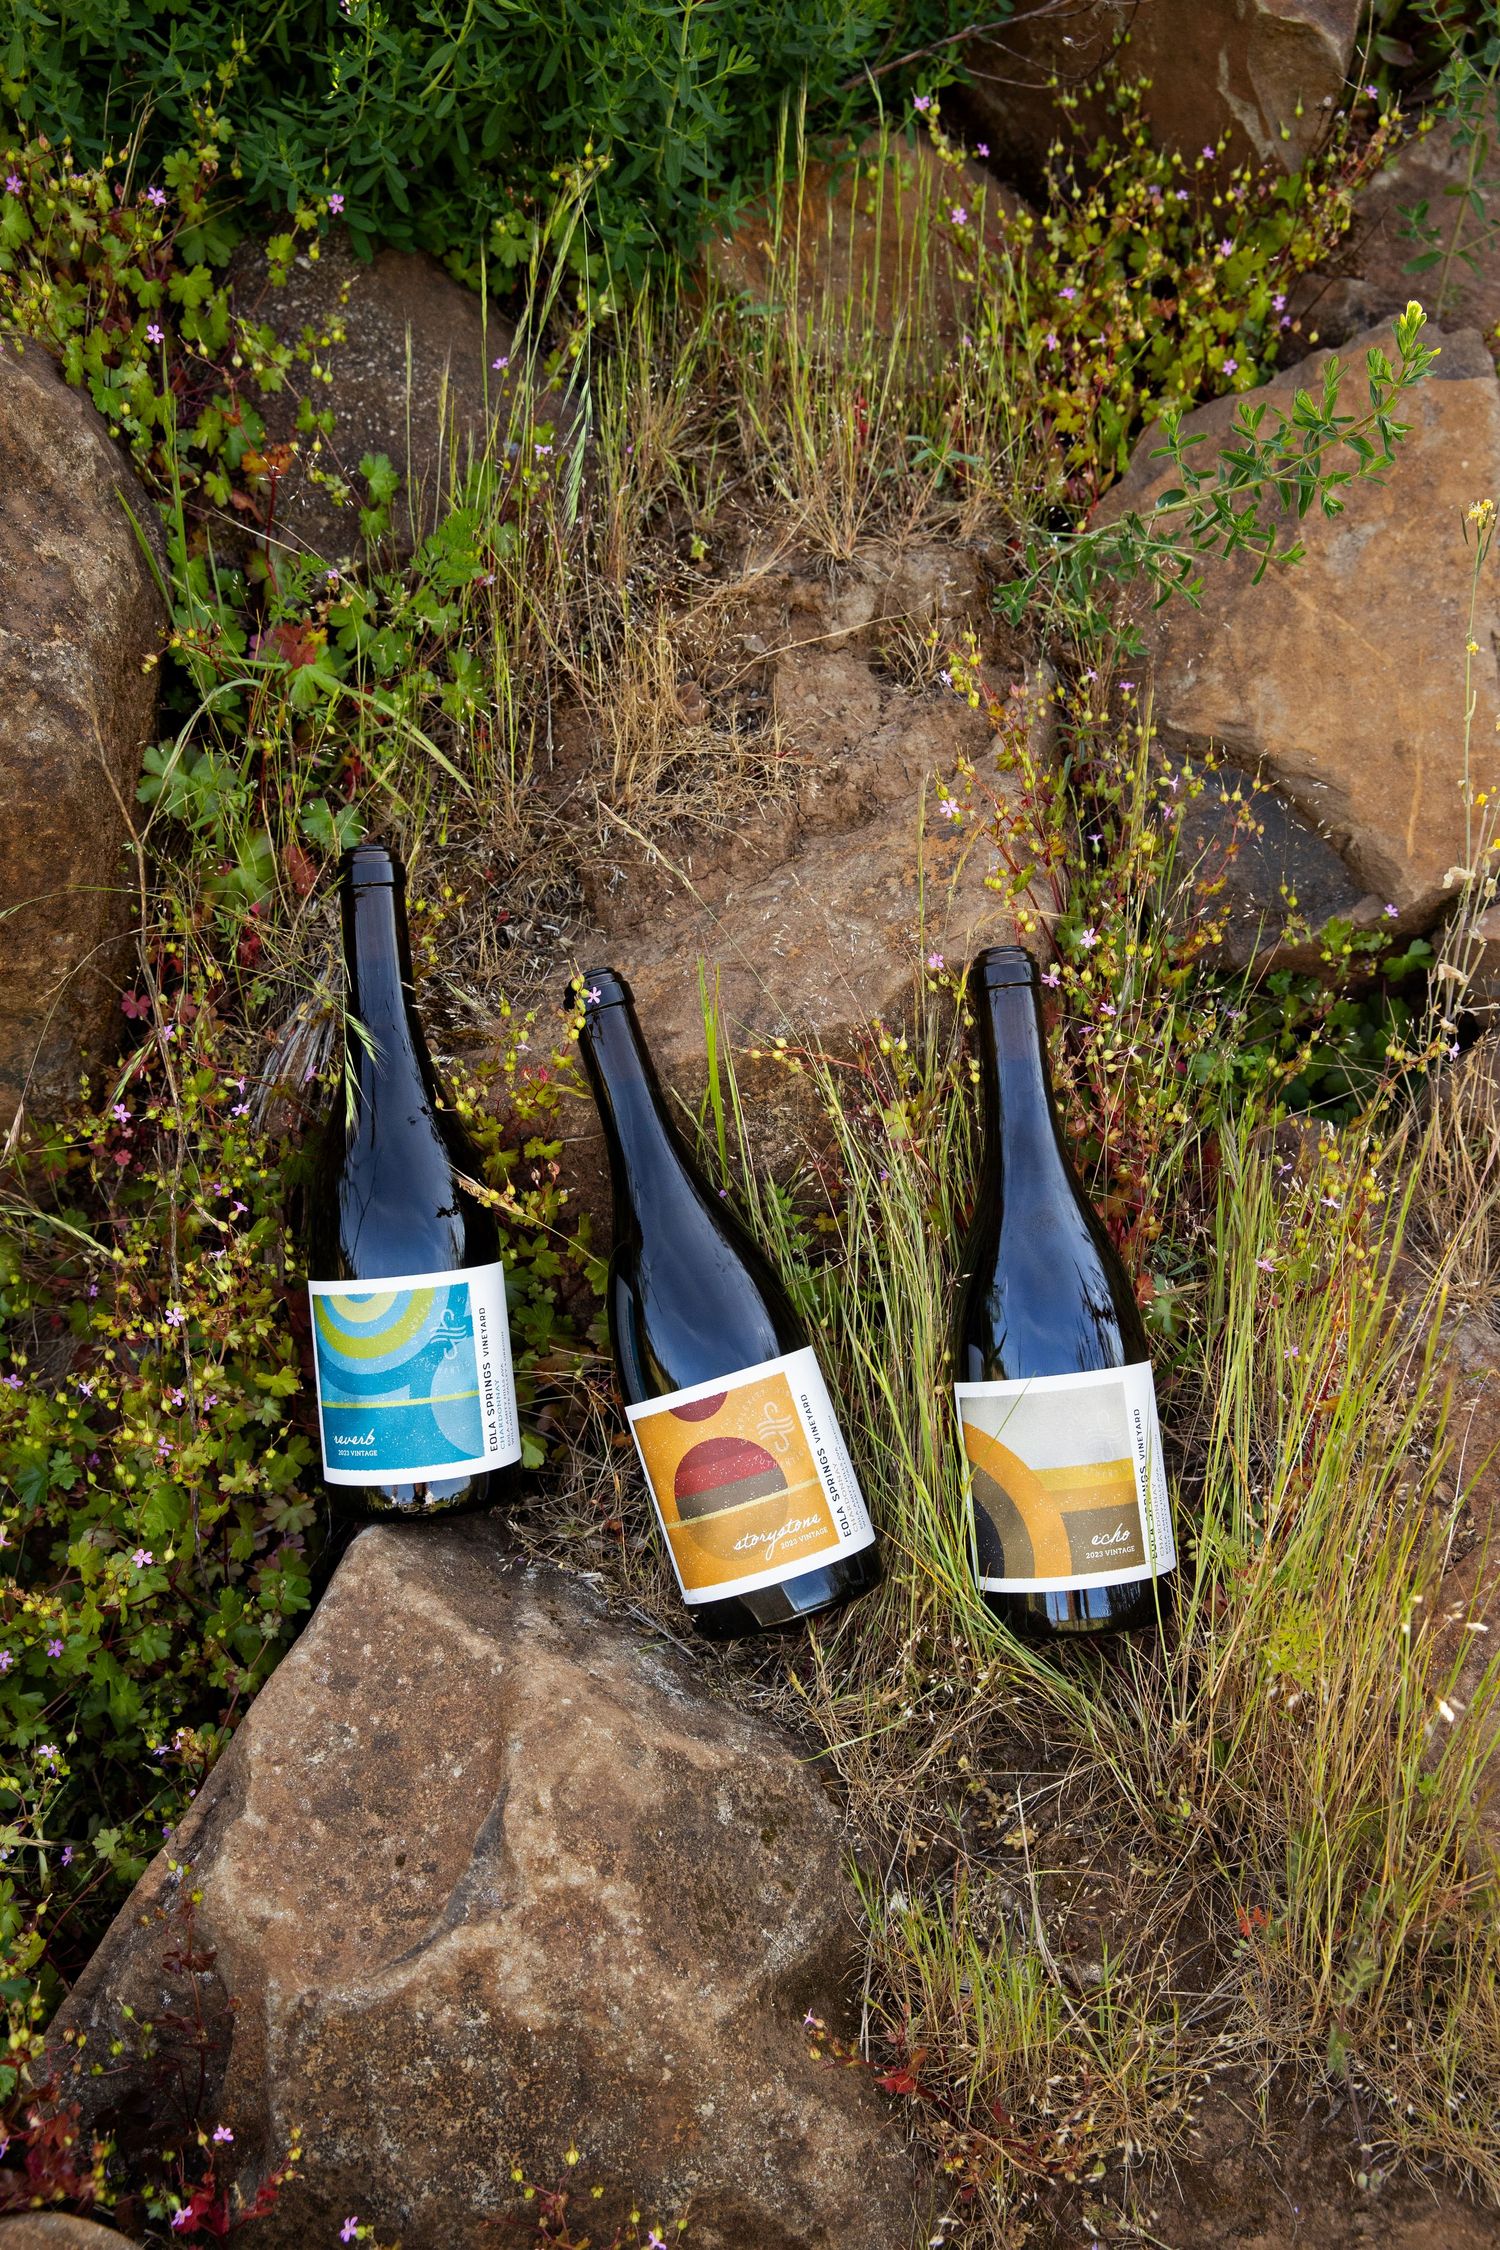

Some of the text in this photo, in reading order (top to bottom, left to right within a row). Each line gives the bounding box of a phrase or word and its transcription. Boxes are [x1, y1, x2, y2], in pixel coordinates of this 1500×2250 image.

[478, 1307, 499, 1452] EOLA SPRINGS VINEYARD
[333, 1428, 376, 1446] reverb
[494, 1379, 506, 1450] CHARDONNAY
[800, 1394, 821, 1443] VINEYARD
[1133, 1408, 1146, 1461] VINEYARD
[350, 1449, 378, 1457] VINTAGE
[817, 1447, 841, 1502] SPRINGS
[832, 1463, 859, 1533] CHARDONNAY
[836, 1506, 852, 1538] EOLA
[1151, 1483, 1165, 1556] CHARDONNAY
[733, 1513, 822, 1561] storystone
[780, 1526, 829, 1550] 2023 VINTAGE
[1085, 1545, 1136, 1559] 2023 VINTAGE
[1091, 1522, 1131, 1546] echo
